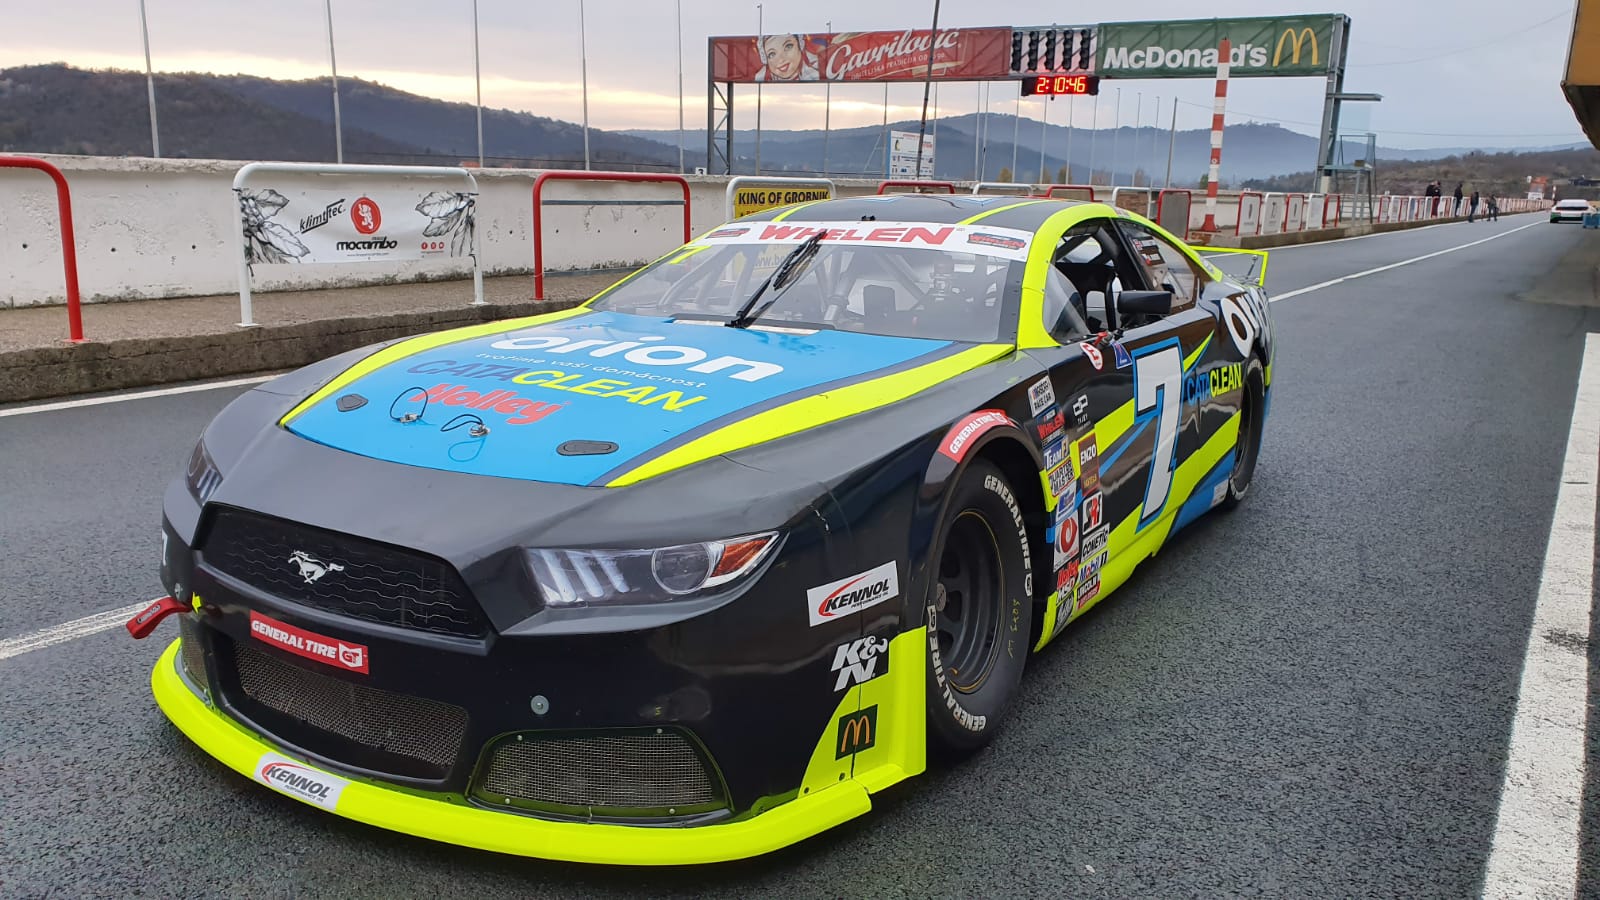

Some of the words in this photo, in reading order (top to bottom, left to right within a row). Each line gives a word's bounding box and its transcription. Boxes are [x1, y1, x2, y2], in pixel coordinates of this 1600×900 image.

[1103, 43, 1268, 69] McDonad's
[1036, 76, 1087, 93] 2:10:46
[738, 192, 766, 205] KING
[767, 191, 783, 204] OF
[783, 191, 829, 204] GROBNIK
[336, 236, 398, 250] mocambo
[759, 224, 955, 245] WHELEN
[490, 336, 784, 383] orion
[551, 359, 593, 368] vaši
[592, 365, 707, 388] domácnost
[409, 383, 564, 425] Holley
[949, 418, 982, 454] GENERAL
[1132, 339, 1184, 524] 7
[1080, 444, 1097, 466] ENZO
[983, 474, 1024, 528] GENERAL
[1018, 525, 1032, 570] TIRE
[825, 578, 890, 612] KENNOL
[251, 620, 304, 650] GENERAL
[305, 639, 338, 659] TIRE
[942, 683, 987, 732] GENERAL
[267, 766, 330, 799] KENNOL
